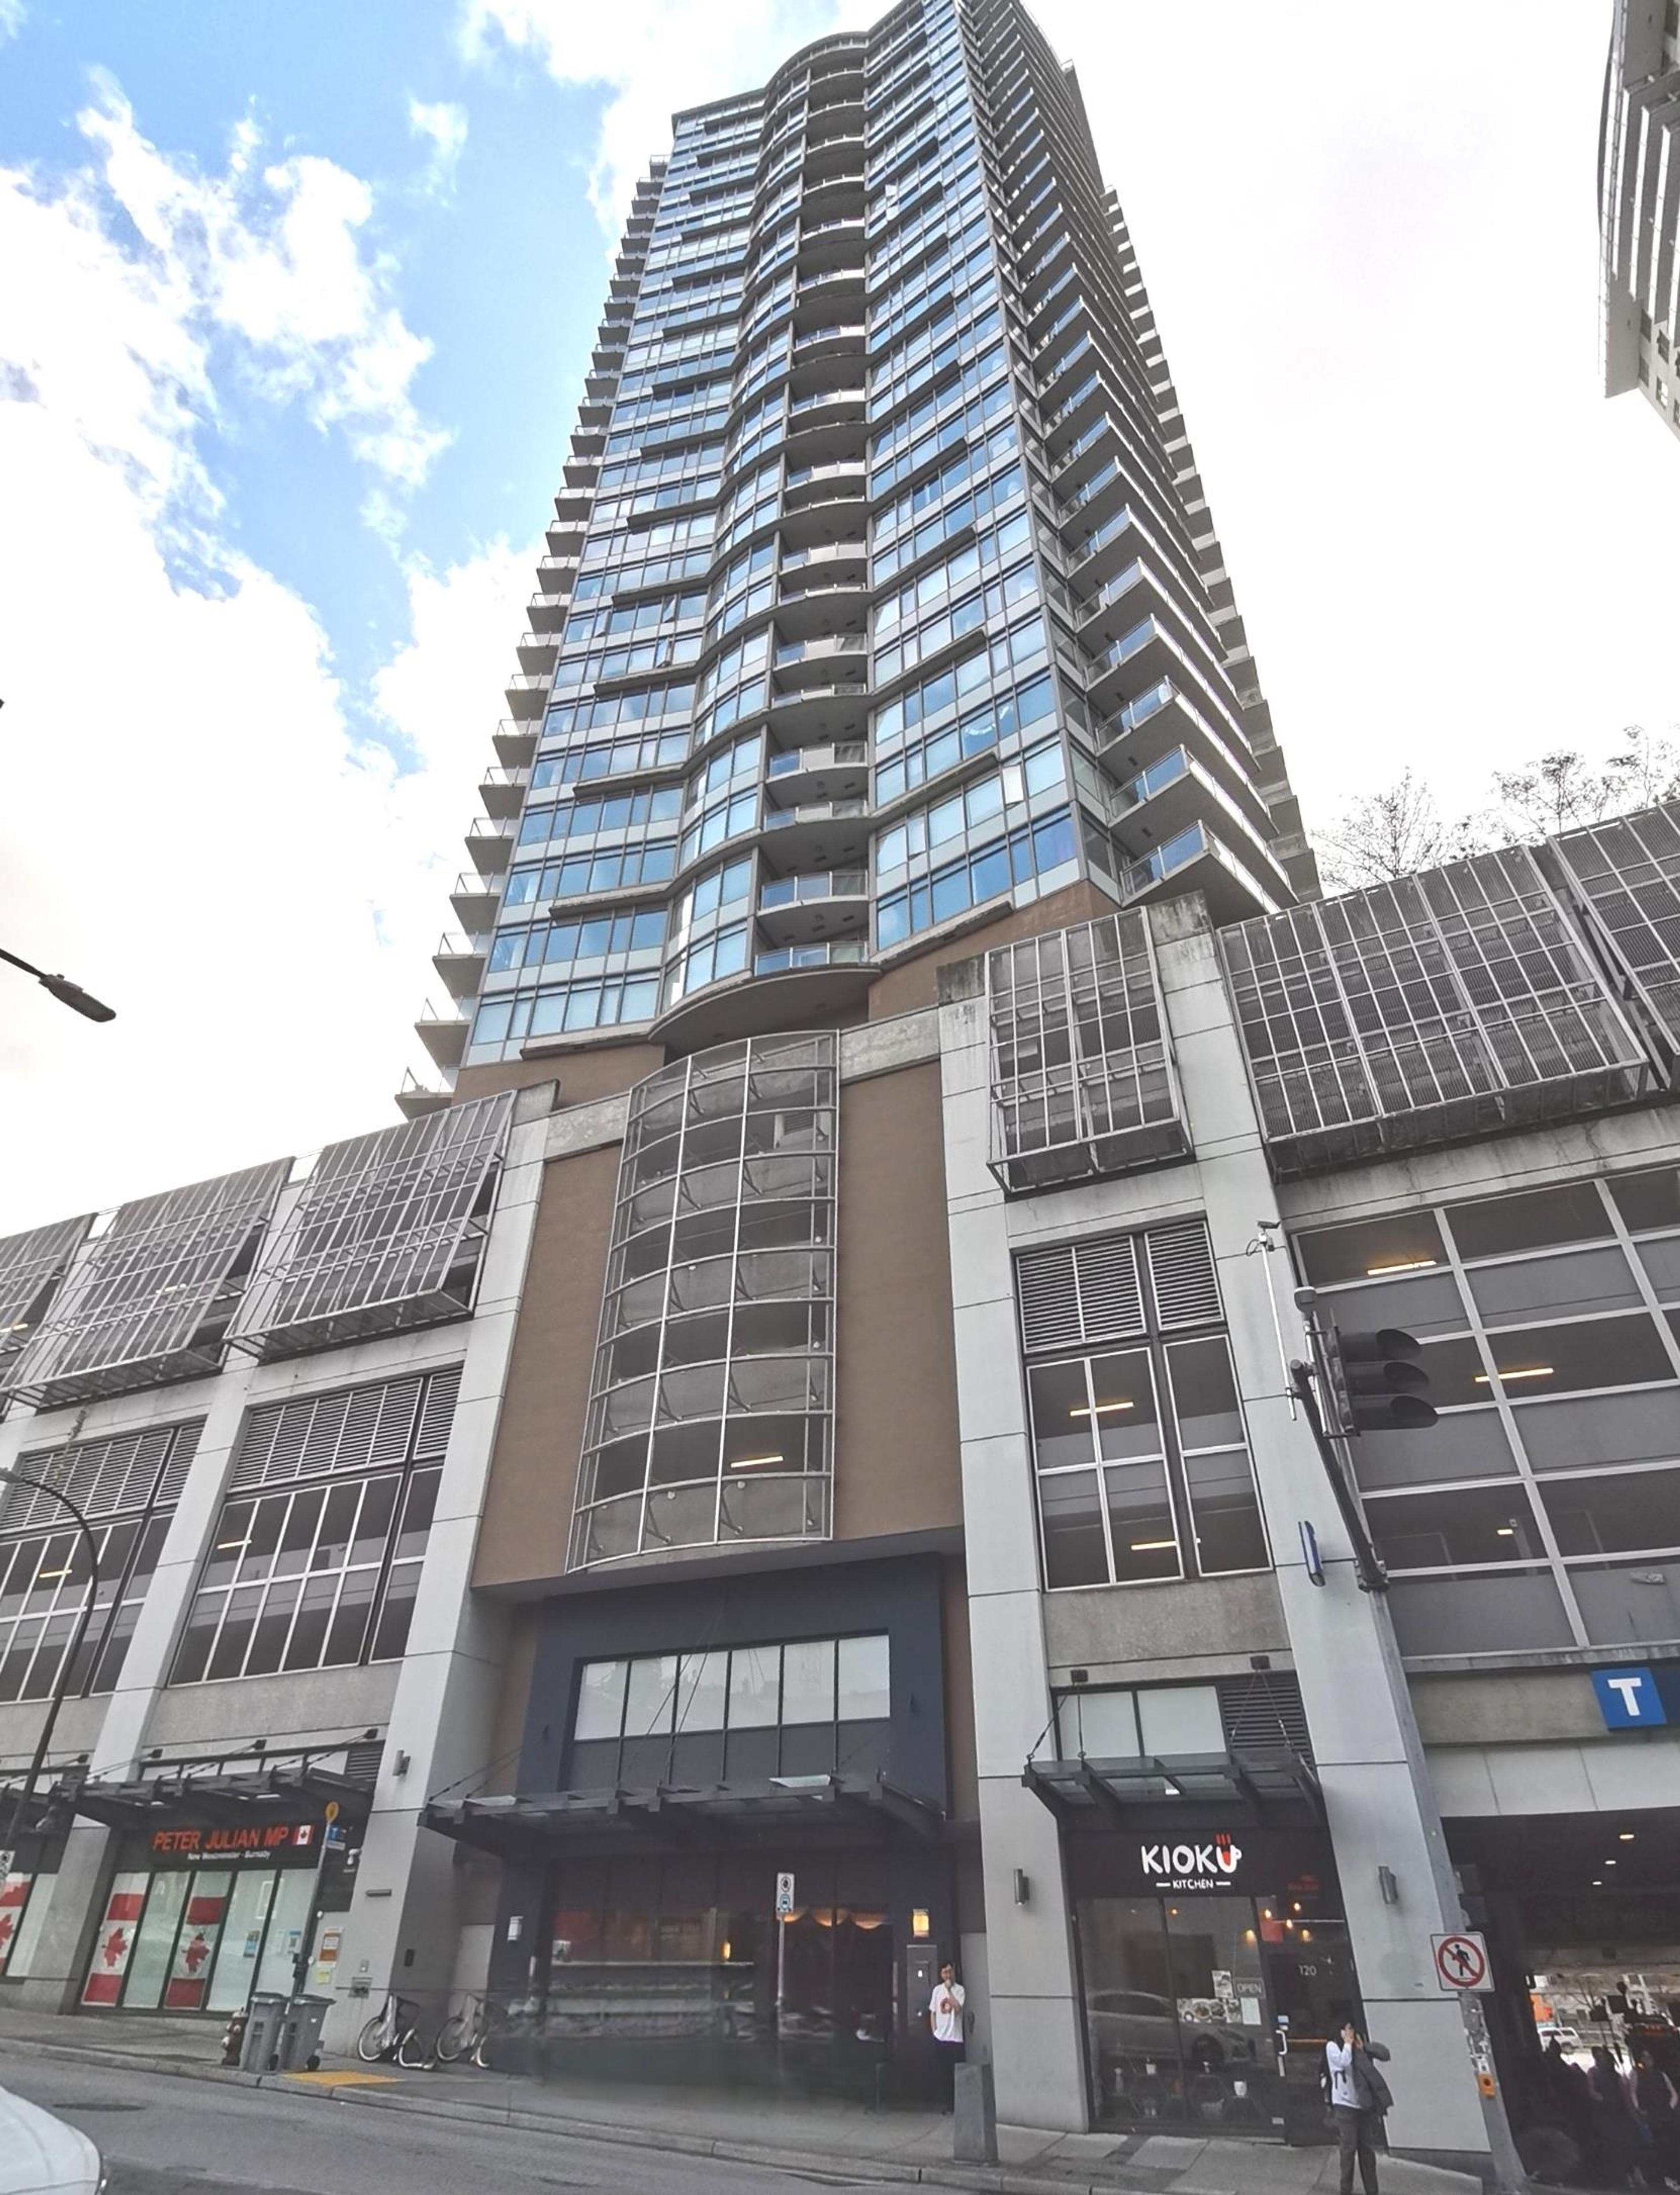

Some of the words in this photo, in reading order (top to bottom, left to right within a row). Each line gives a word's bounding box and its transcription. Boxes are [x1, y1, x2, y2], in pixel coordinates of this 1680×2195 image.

[1607, 1677, 1642, 1716] T
[153, 1831, 201, 1850] PETER
[205, 1828, 261, 1849] JULIAN
[264, 1827, 289, 1846] MP
[1141, 1844, 1242, 1874] KIOKU
[1172, 1879, 1214, 1890] KITCHEN
[1298, 1965, 1317, 1976] 120
[1237, 1983, 1262, 1993] OPEN
